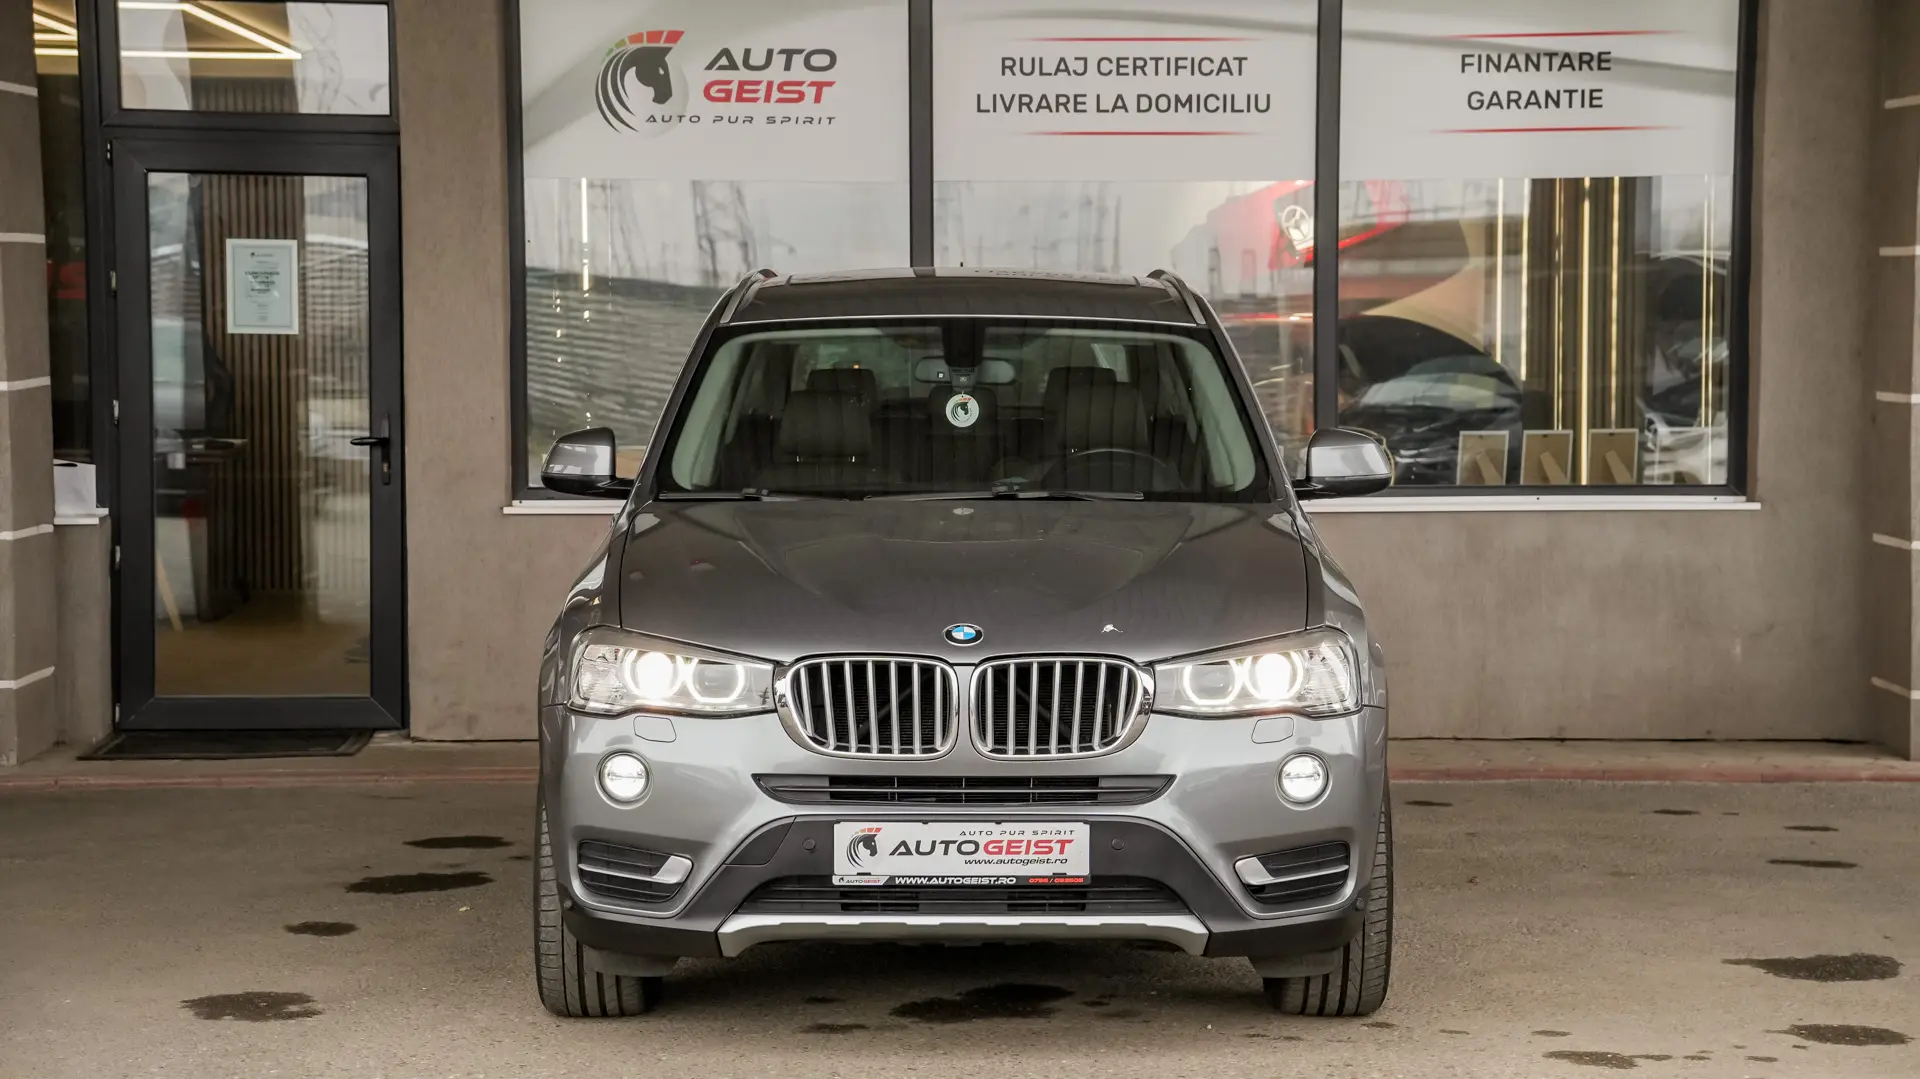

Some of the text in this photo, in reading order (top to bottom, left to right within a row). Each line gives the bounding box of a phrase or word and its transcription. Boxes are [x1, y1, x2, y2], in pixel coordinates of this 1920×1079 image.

[703, 47, 838, 72] AUTO
[1000, 56, 1249, 77] RULAJ CERTIFICAT
[1460, 51, 1612, 74] FINANTARE
[702, 79, 837, 104] GEIST
[1467, 88, 1604, 111] GARANTIE
[976, 93, 1271, 113] LIVRARE LA DOMICILIU
[645, 114, 837, 125] AUTO PUR SPIRIT
[964, 856, 1068, 866] www.autogeist.ro
[895, 876, 1017, 885] WWW.AUTOGEIST.RO
